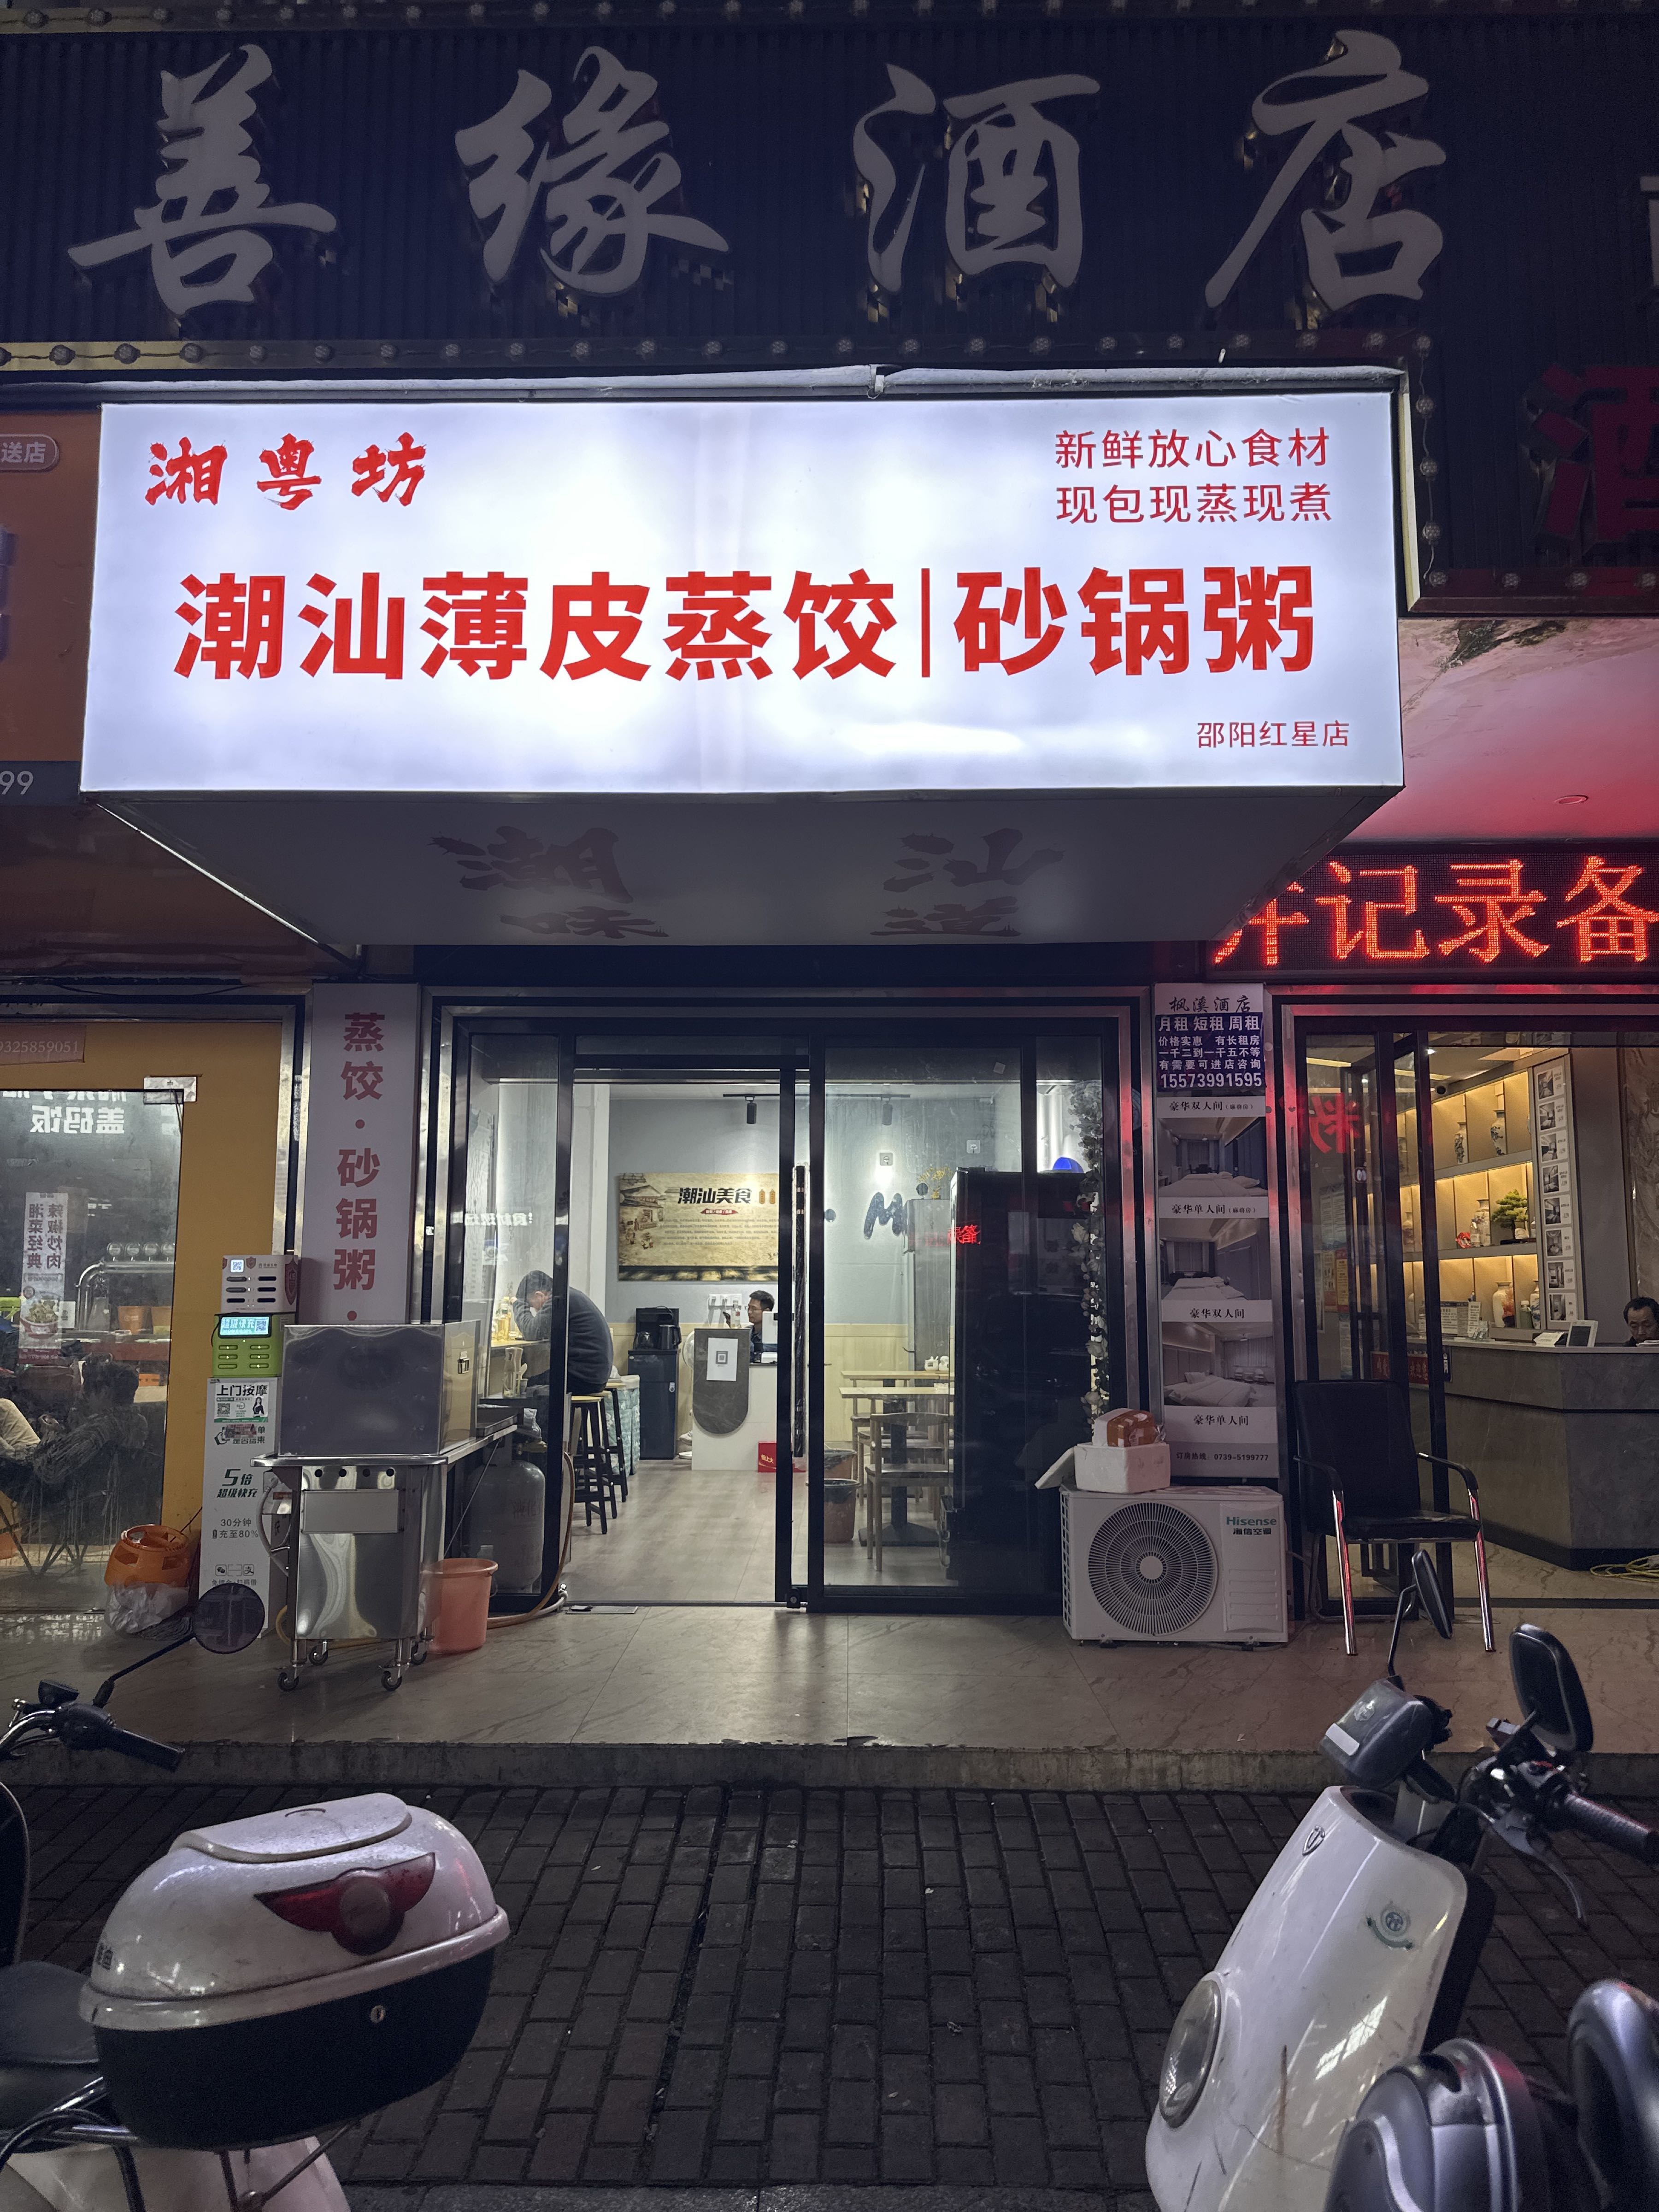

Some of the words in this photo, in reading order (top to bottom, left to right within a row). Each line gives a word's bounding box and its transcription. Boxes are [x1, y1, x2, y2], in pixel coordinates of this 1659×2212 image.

[68, 29, 1446, 318] 善缘酒店
[1055, 427, 1330, 469] 新鲜放心食材
[144, 432, 426, 510] 湘粤坊
[1055, 482, 1332, 524] 现包现蒸现煮
[1196, 720, 1350, 749] 邵阳红星店
[1169, 995, 1252, 1013] 枫溪酒店
[1158, 1016, 1189, 1032] 月租
[1193, 1016, 1224, 1031] 短租
[1229, 1015, 1260, 1031] 周租
[1158, 1035, 1203, 1046] 价格实惠
[1215, 1035, 1260, 1046] 有长租房
[1159, 1047, 1261, 1058] 一千二到一千五不等
[1159, 1059, 1262, 1070] 有需要可进店咨询
[1160, 1072, 1263, 1088] 15573991595
[677, 1187, 753, 1204] 潮汕美食
[1189, 1308, 1246, 1319] 豪华双人间
[217, 1385, 268, 1396] 上门按摩
[1193, 1414, 1249, 1426] 豪华单人间
[222, 1469, 253, 1486] 5倍
[217, 1488, 259, 1498] 超级快充
[221, 1518, 252, 1527] 30分钟
[1226, 1516, 1277, 1526] Hisense
[219, 1529, 259, 1539] 充至80%
